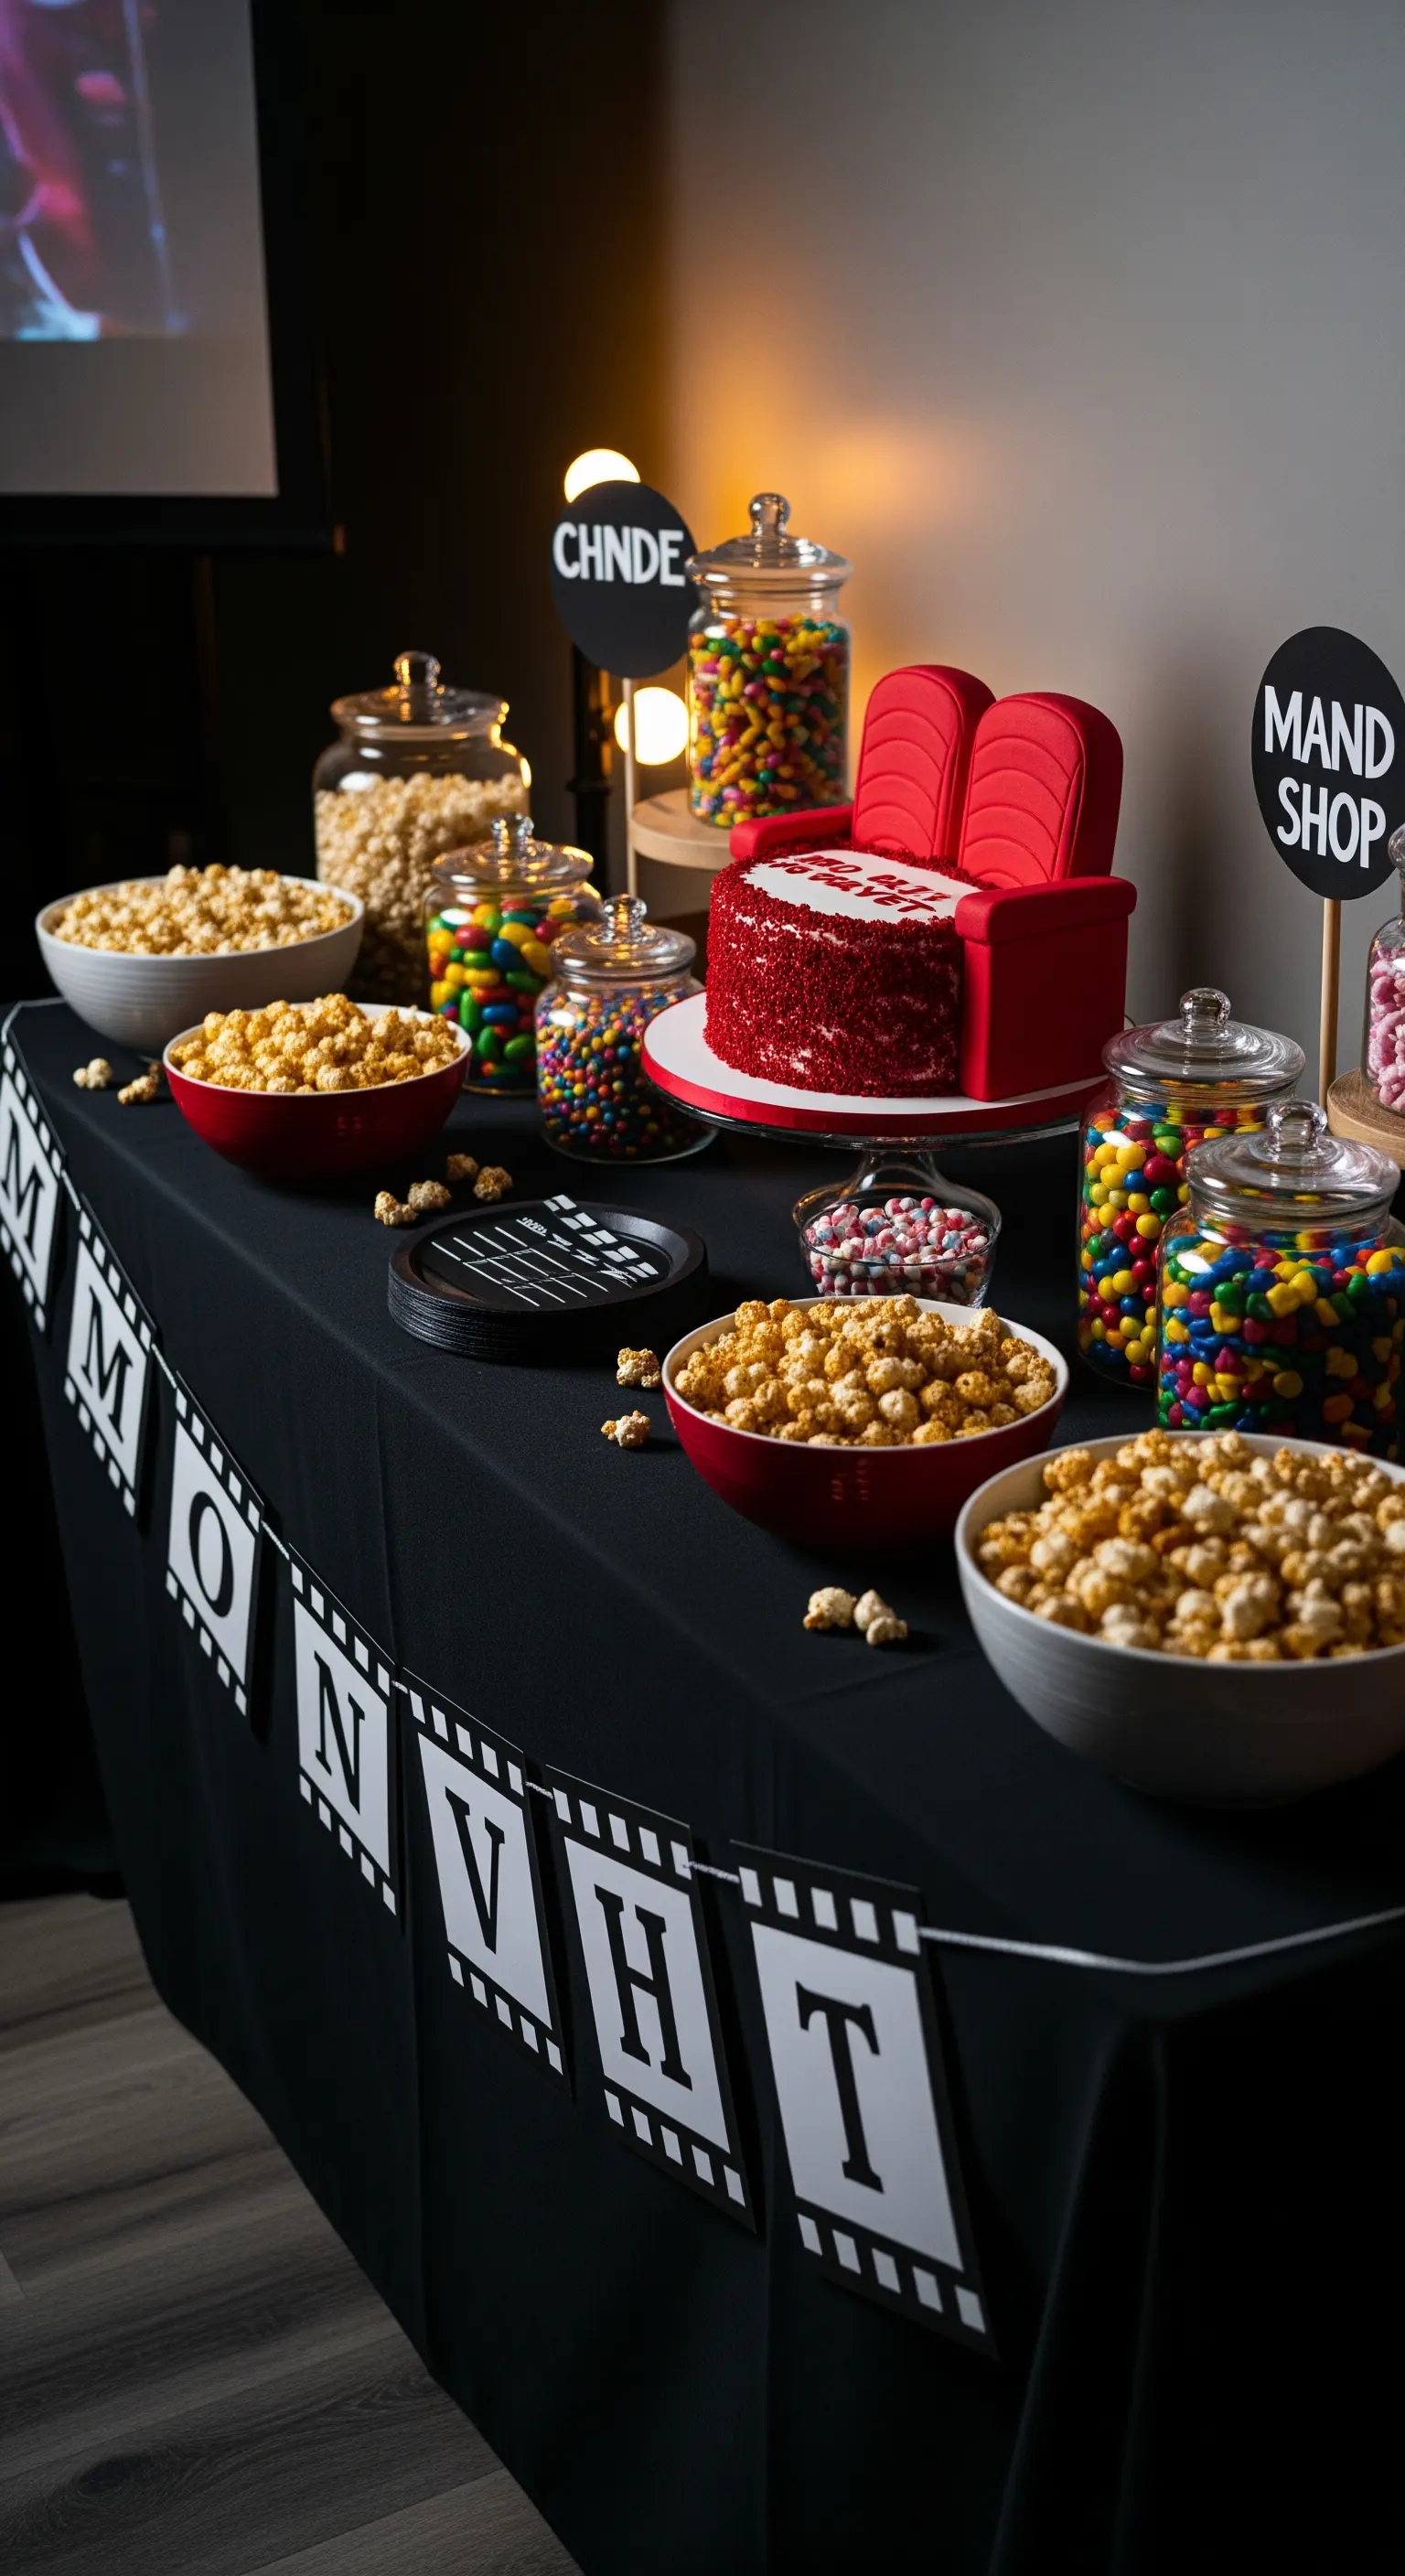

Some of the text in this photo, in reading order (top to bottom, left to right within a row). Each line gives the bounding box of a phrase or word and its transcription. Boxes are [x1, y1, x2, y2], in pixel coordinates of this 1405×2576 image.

[552, 521, 686, 587] CHNDE
[1264, 685, 1395, 779] MAND
[1277, 777, 1387, 869] SHOP
